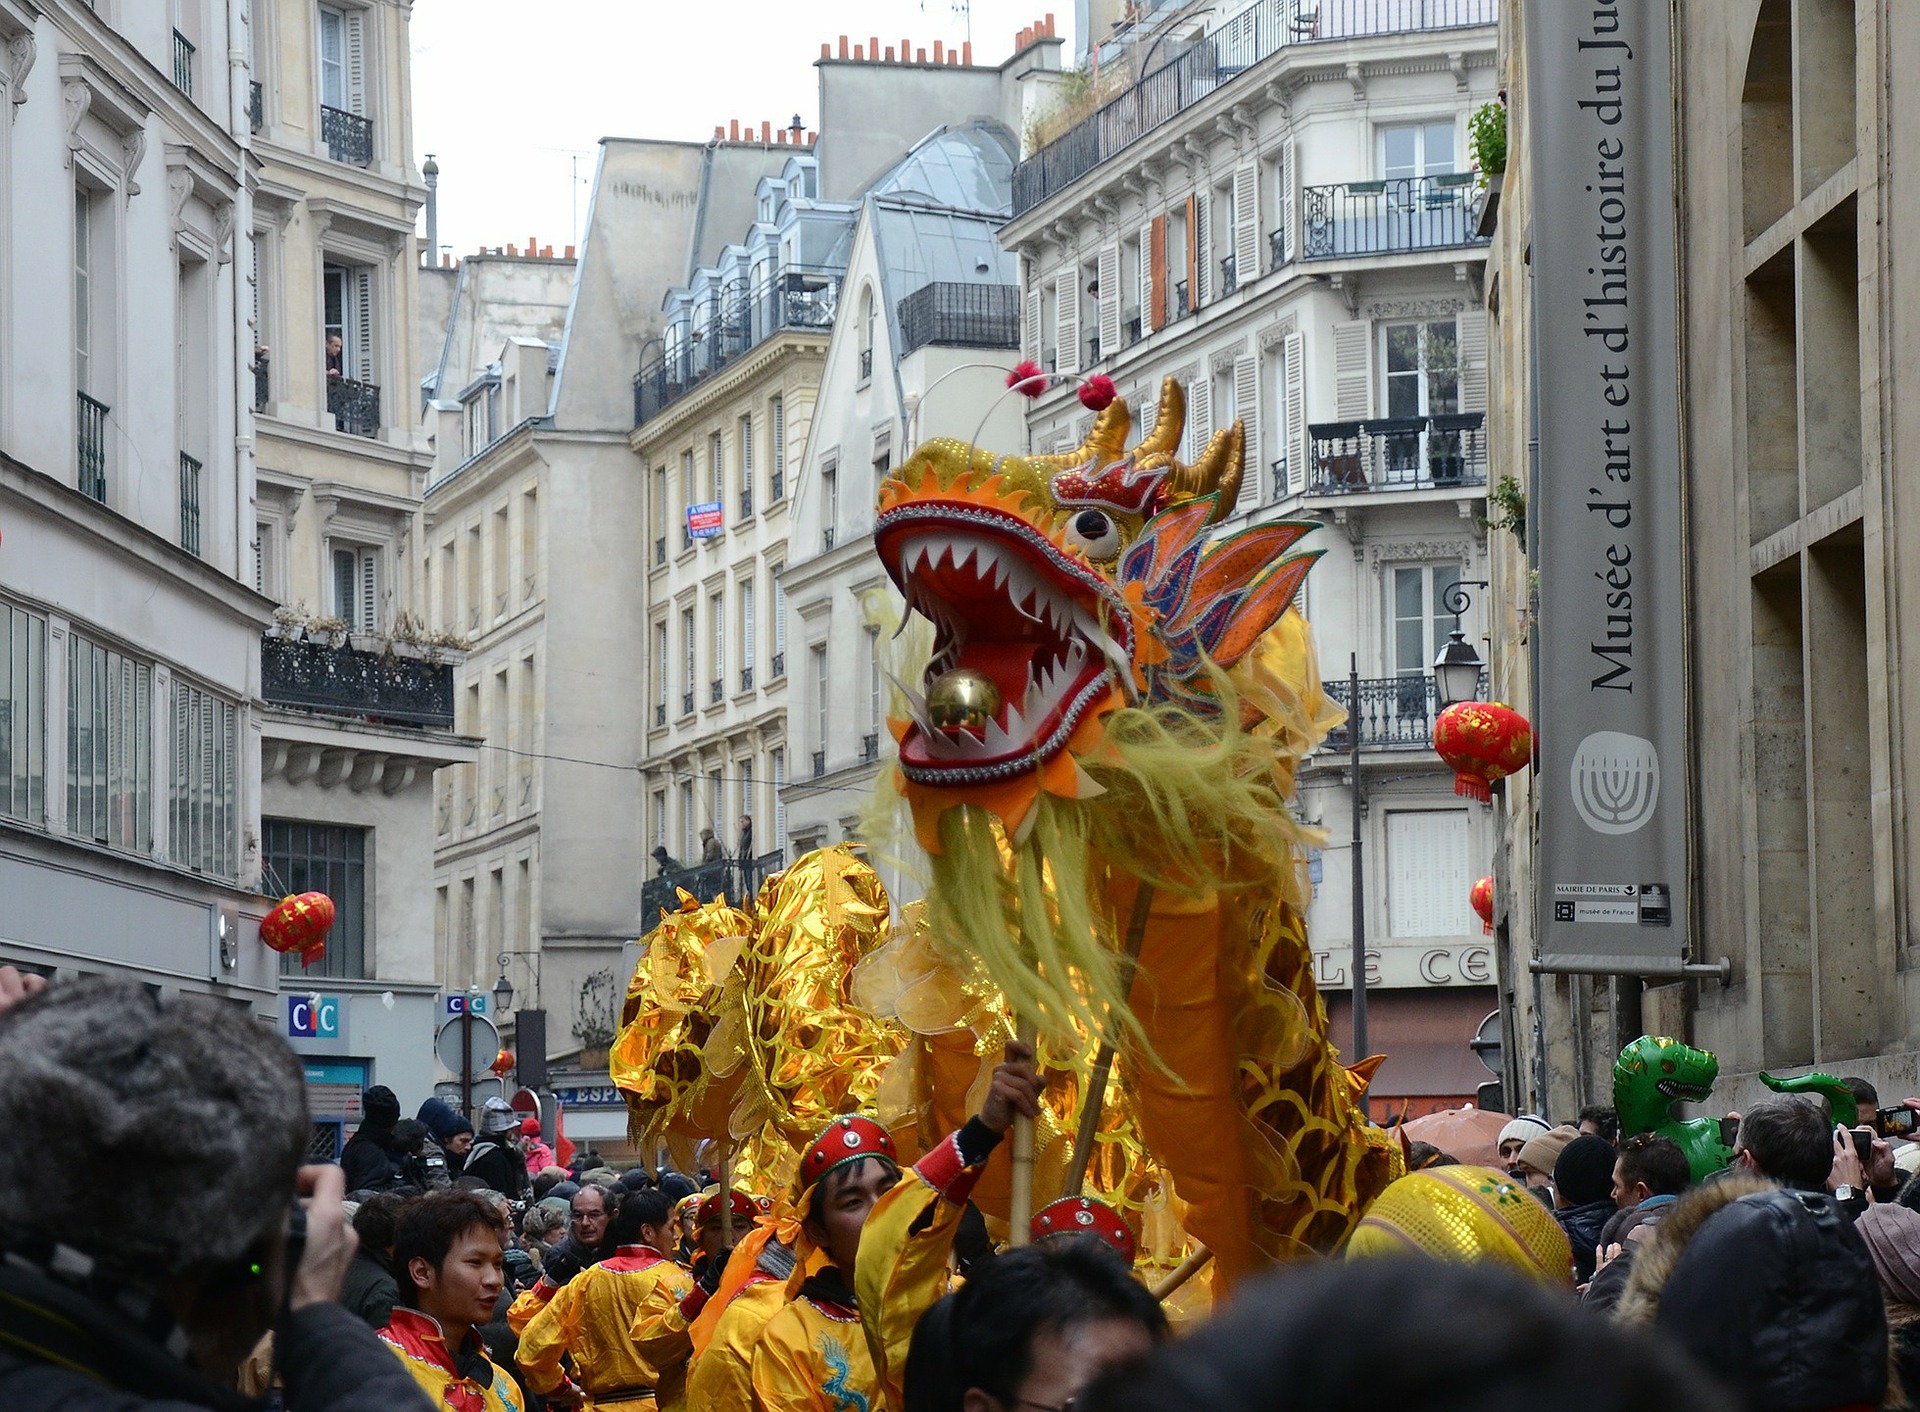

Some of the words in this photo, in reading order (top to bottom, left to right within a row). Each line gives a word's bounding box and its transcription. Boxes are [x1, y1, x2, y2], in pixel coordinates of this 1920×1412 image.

[1578, 0, 1633, 60] Ju
[1577, 65, 1622, 125] du
[1583, 137, 1629, 353] d'histoire
[1600, 364, 1630, 407] et
[1586, 419, 1632, 529] d'art
[1591, 543, 1633, 694] Musée
[1613, 908, 1635, 916] France
[450, 998, 483, 1011] CIC
